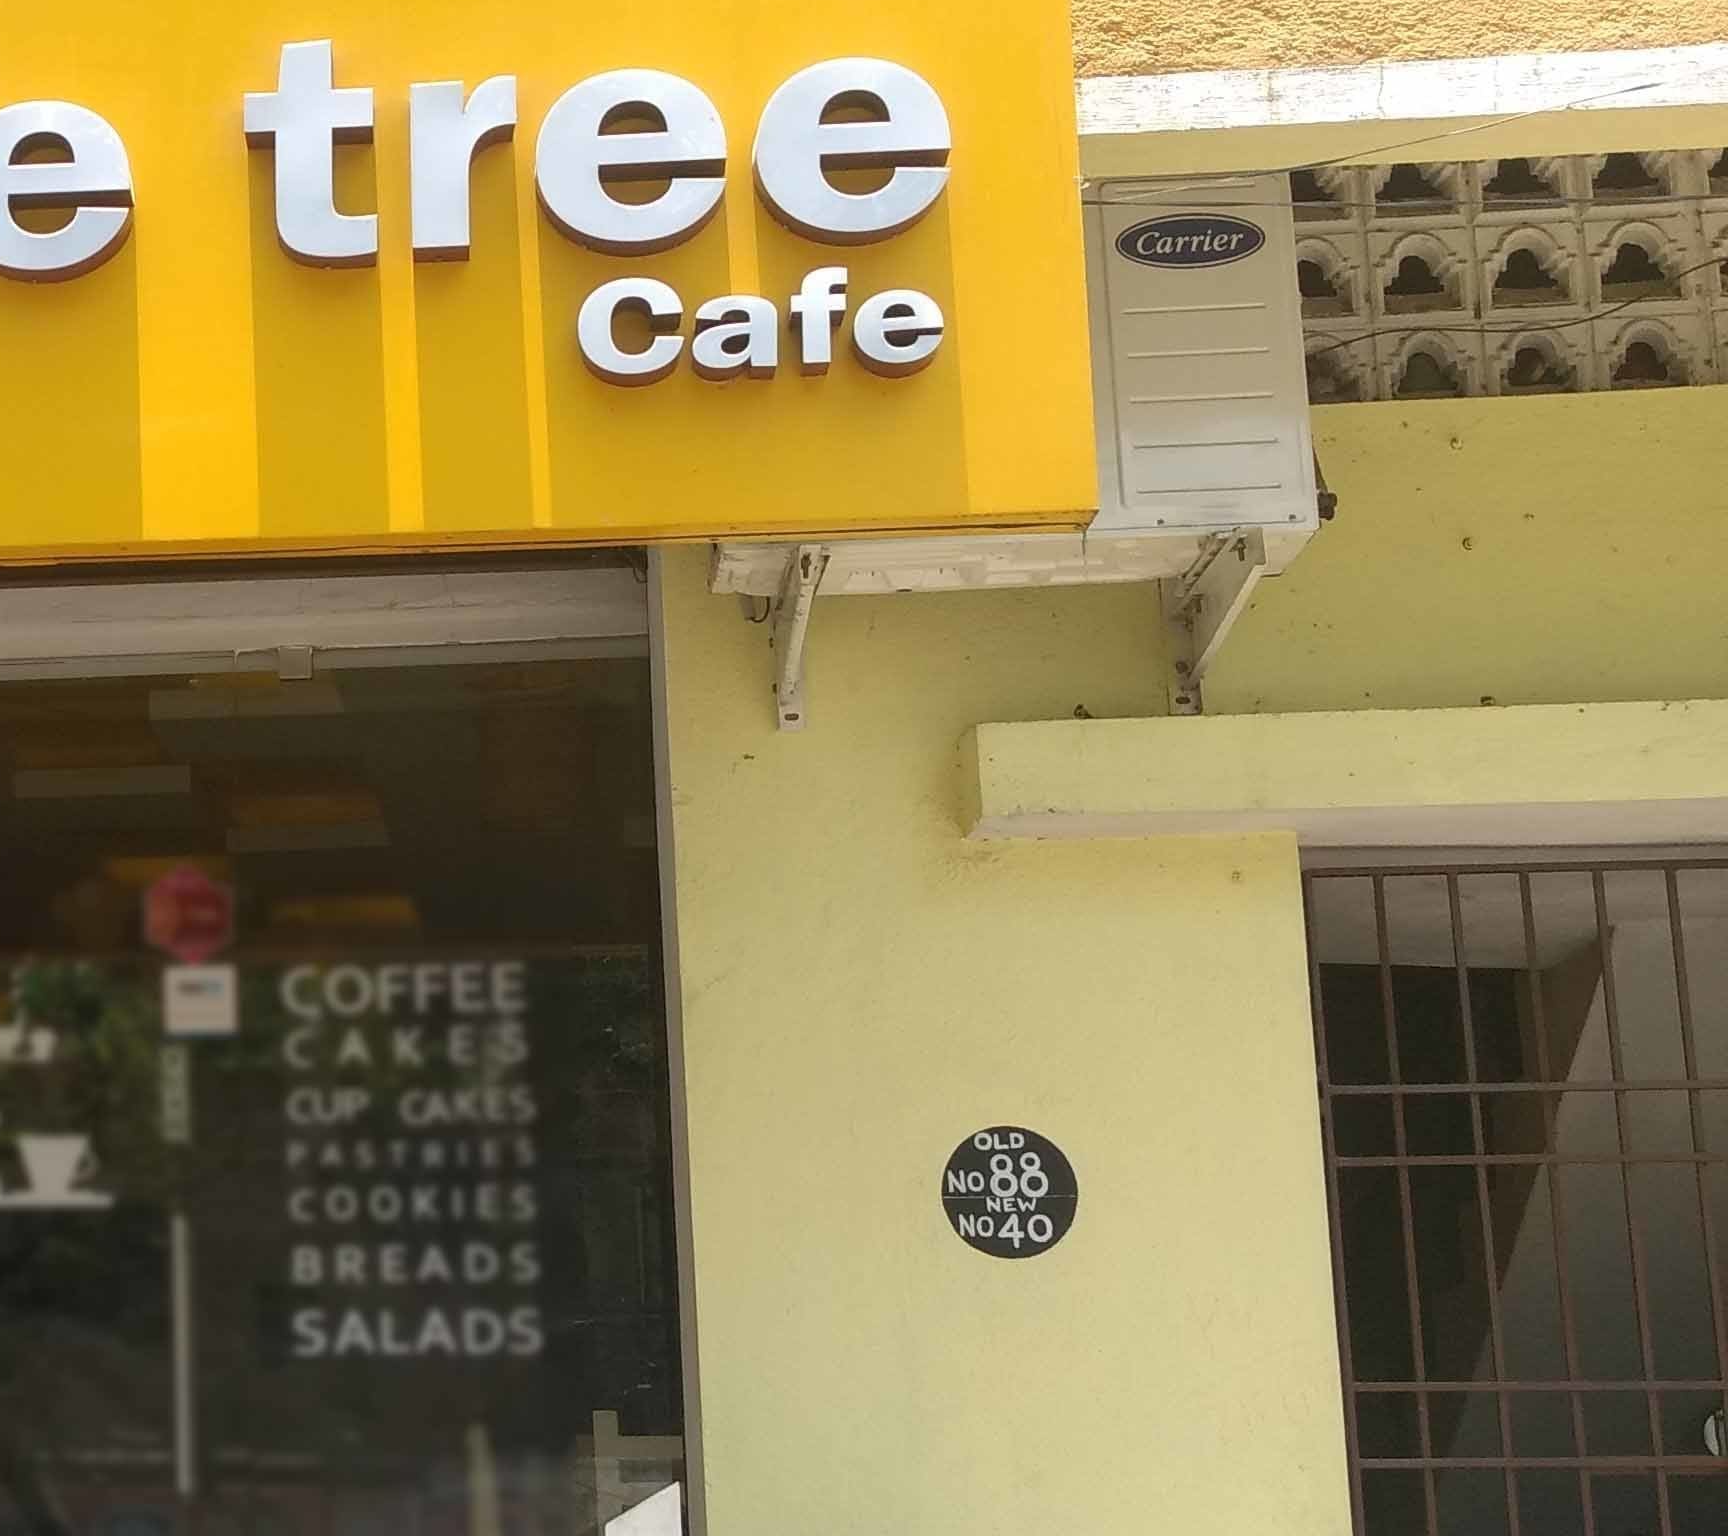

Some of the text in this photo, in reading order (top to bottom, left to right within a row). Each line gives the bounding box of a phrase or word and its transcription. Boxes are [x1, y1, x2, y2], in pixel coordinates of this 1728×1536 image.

[243, 39, 952, 268] tree
[1136, 229, 1244, 255] Carrier
[578, 267, 944, 386] Cafe
[280, 963, 526, 1017] COFFEE
[282, 1020, 529, 1068] CAKES
[285, 1084, 537, 1126] CUP CAKES
[286, 1135, 535, 1169] PASTRIES
[974, 1132, 1025, 1150] OLD
[947, 1151, 1049, 1198] NO 88
[289, 1183, 537, 1223] COOKIES
[986, 1196, 1037, 1212] NEW
[958, 1213, 1053, 1249] NO 40
[290, 1241, 541, 1286] BREADS
[291, 1305, 544, 1357] SALADS
